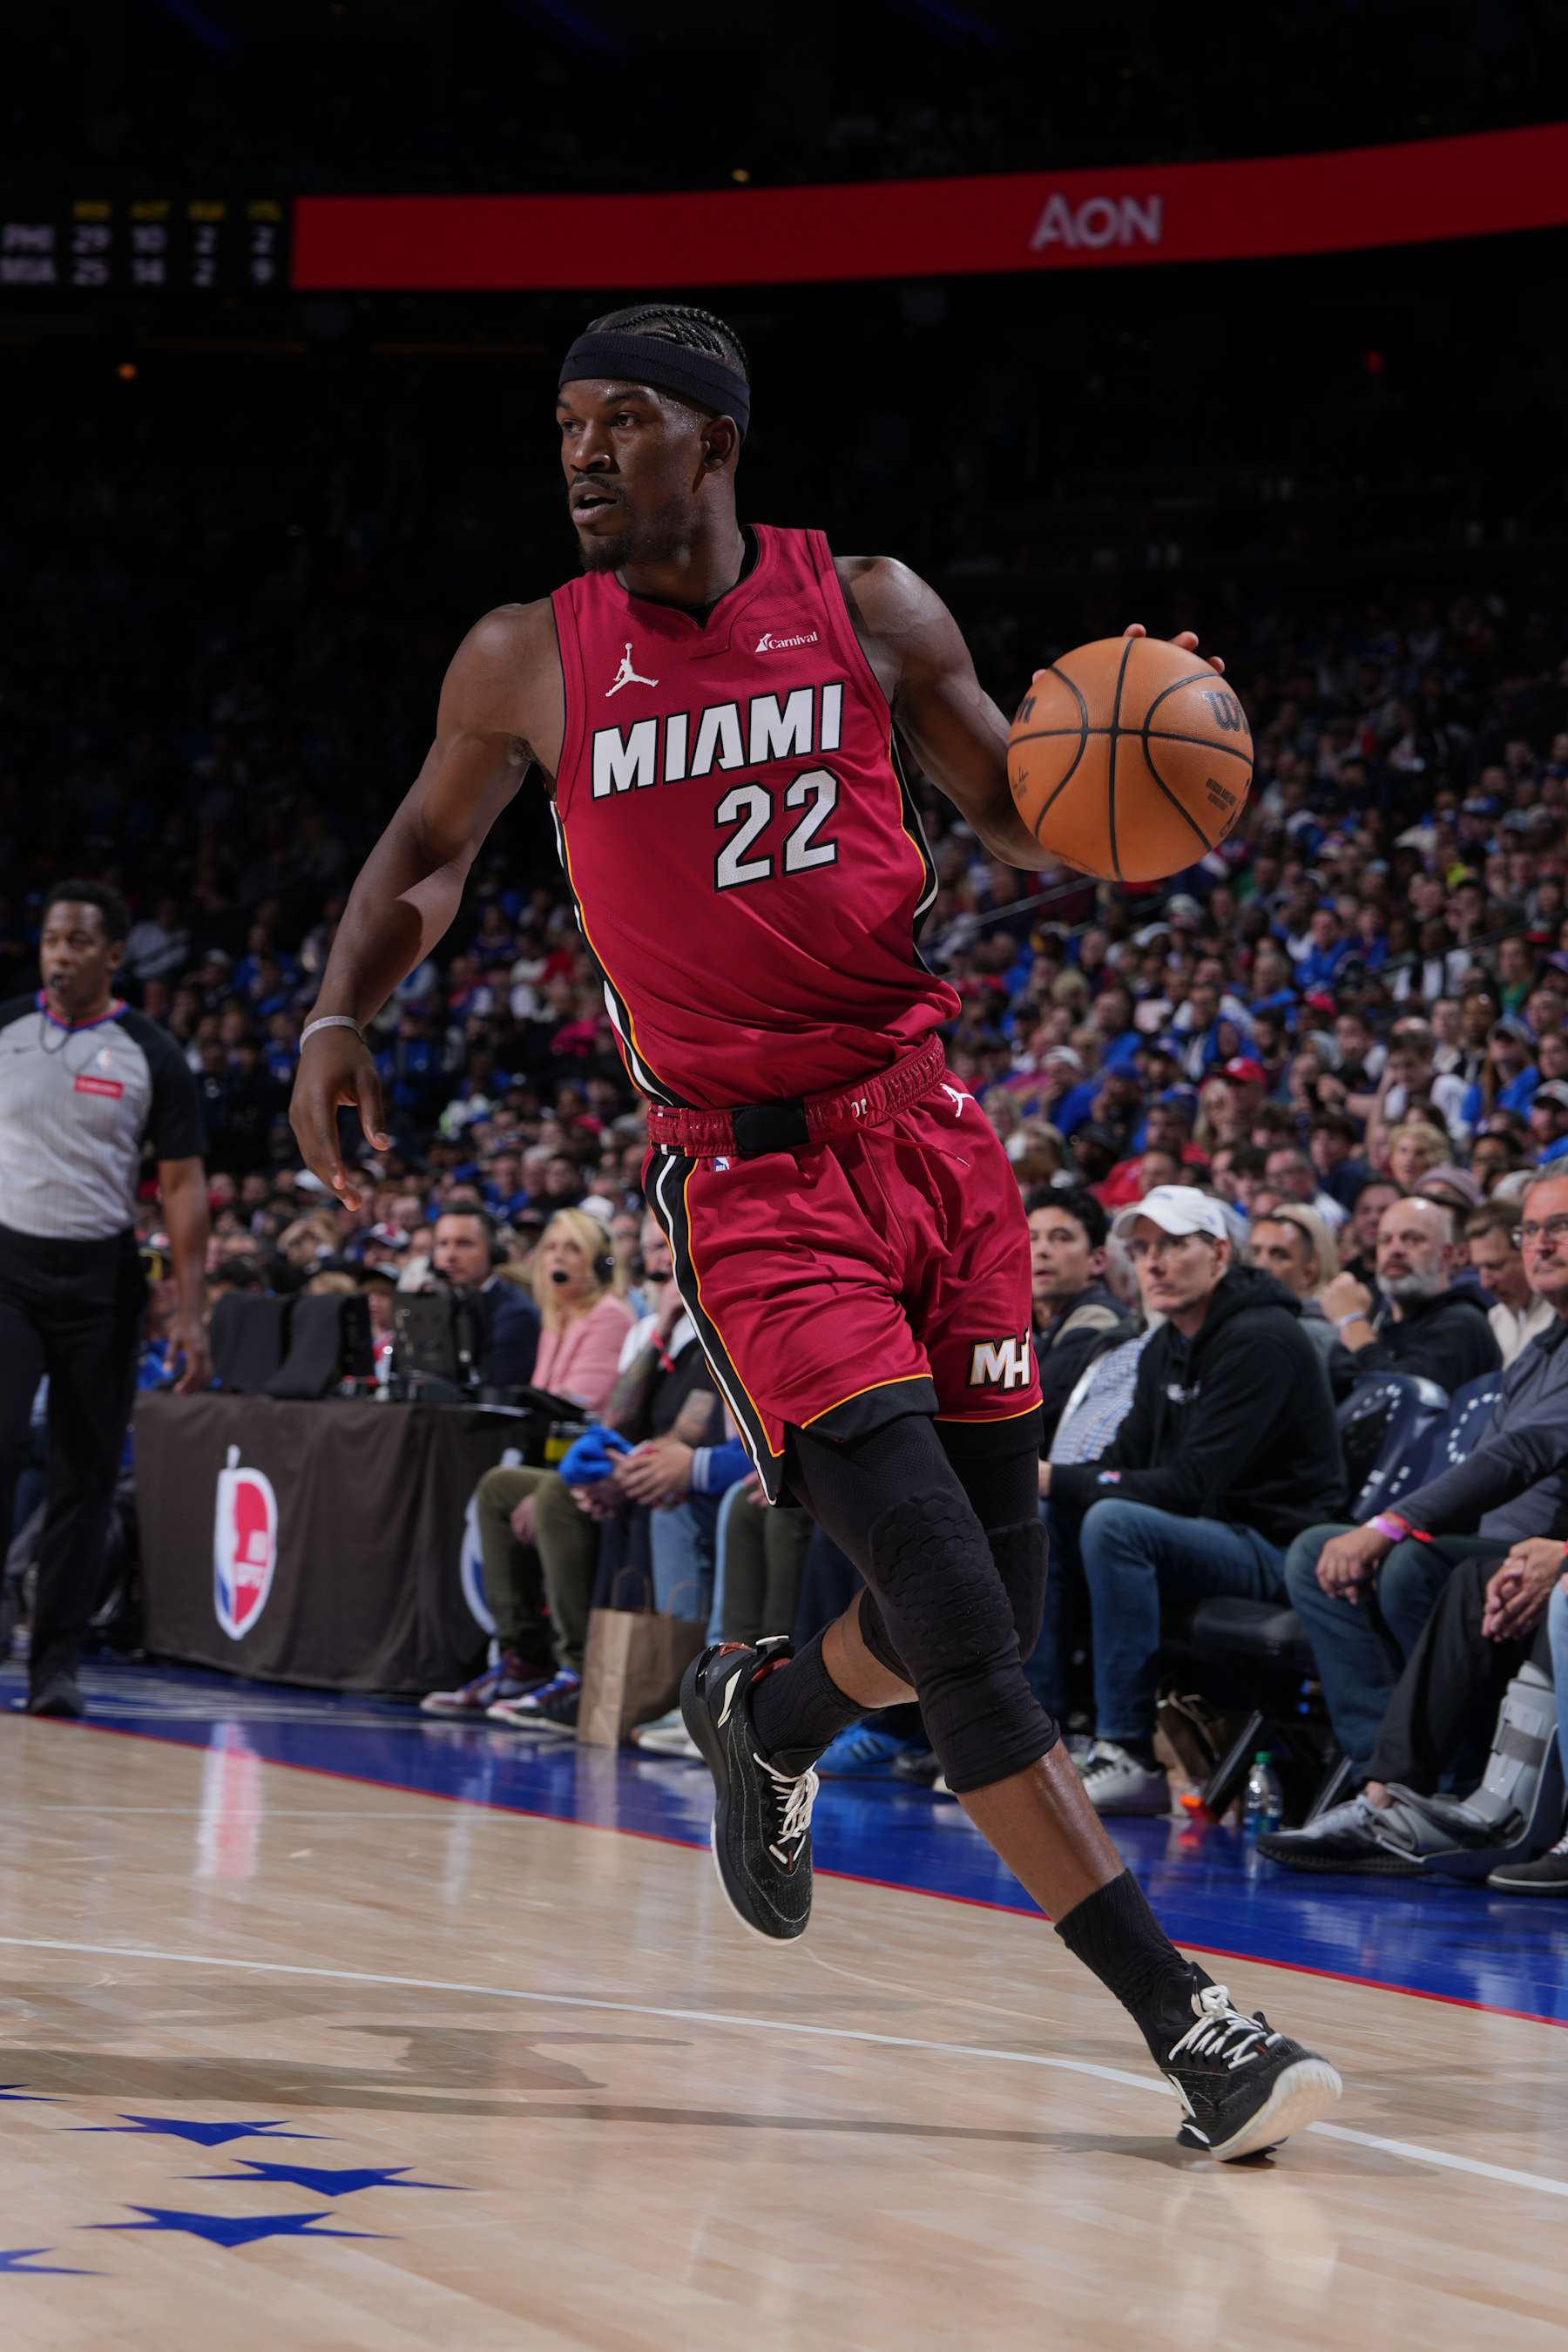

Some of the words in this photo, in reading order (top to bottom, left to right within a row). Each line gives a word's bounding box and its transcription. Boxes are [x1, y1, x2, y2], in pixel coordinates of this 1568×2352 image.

[1030, 193, 1163, 252] AON
[768, 632, 818, 649] Carnival
[592, 682, 843, 800] MIAMI
[713, 767, 839, 892] 22
